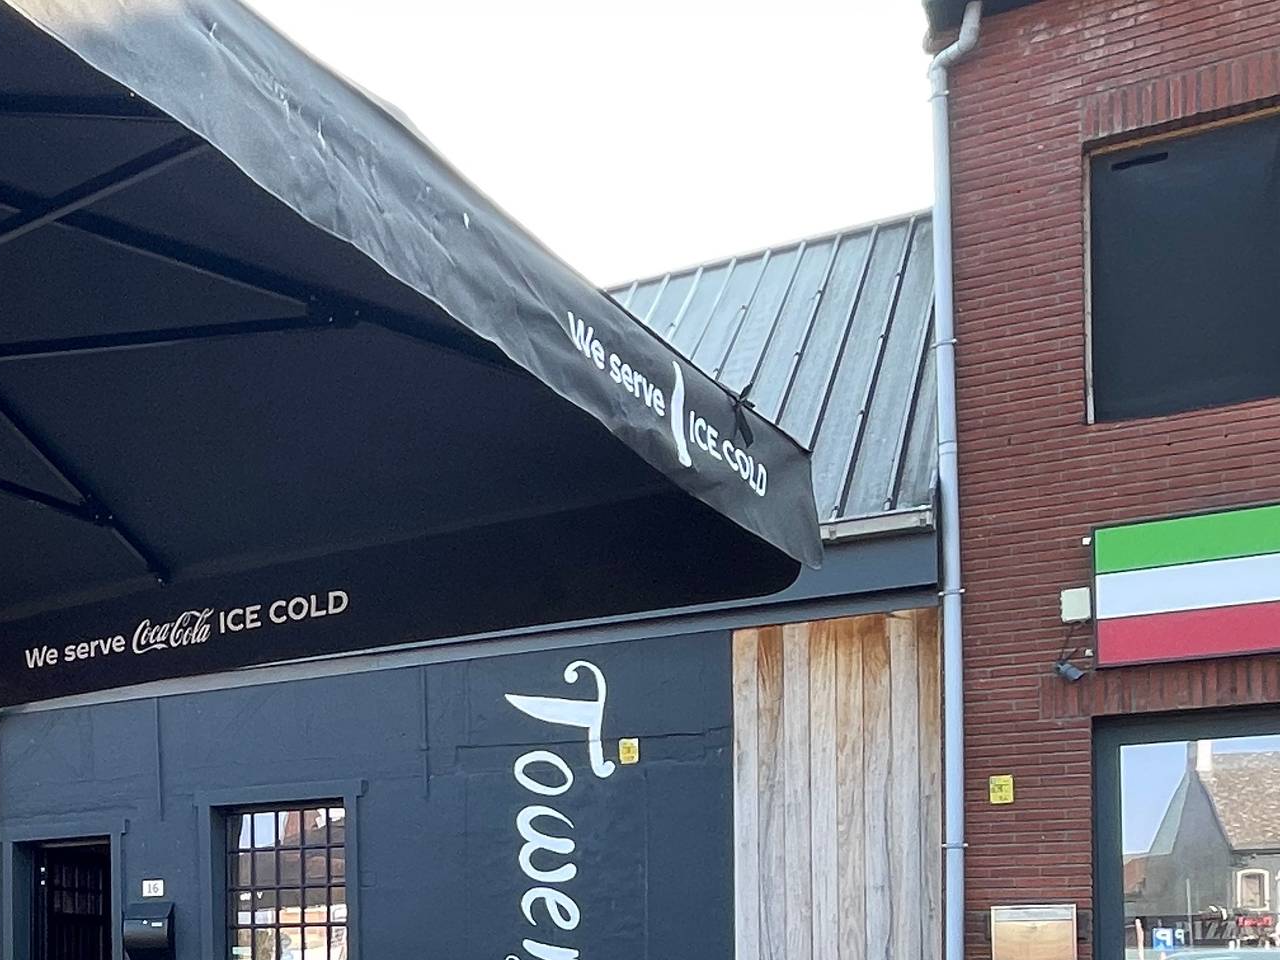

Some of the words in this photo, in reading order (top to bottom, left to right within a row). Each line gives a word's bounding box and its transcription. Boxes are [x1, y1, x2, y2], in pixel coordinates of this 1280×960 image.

[567, 311, 605, 370] We
[609, 353, 666, 416] serve
[688, 410, 723, 461] ICE
[722, 439, 768, 497] COLD
[25, 645, 59, 669] We
[64, 634, 126, 662] serve
[219, 604, 262, 634] ICE
[269, 590, 350, 625] COLD
[147, 883, 160, 894] 16
